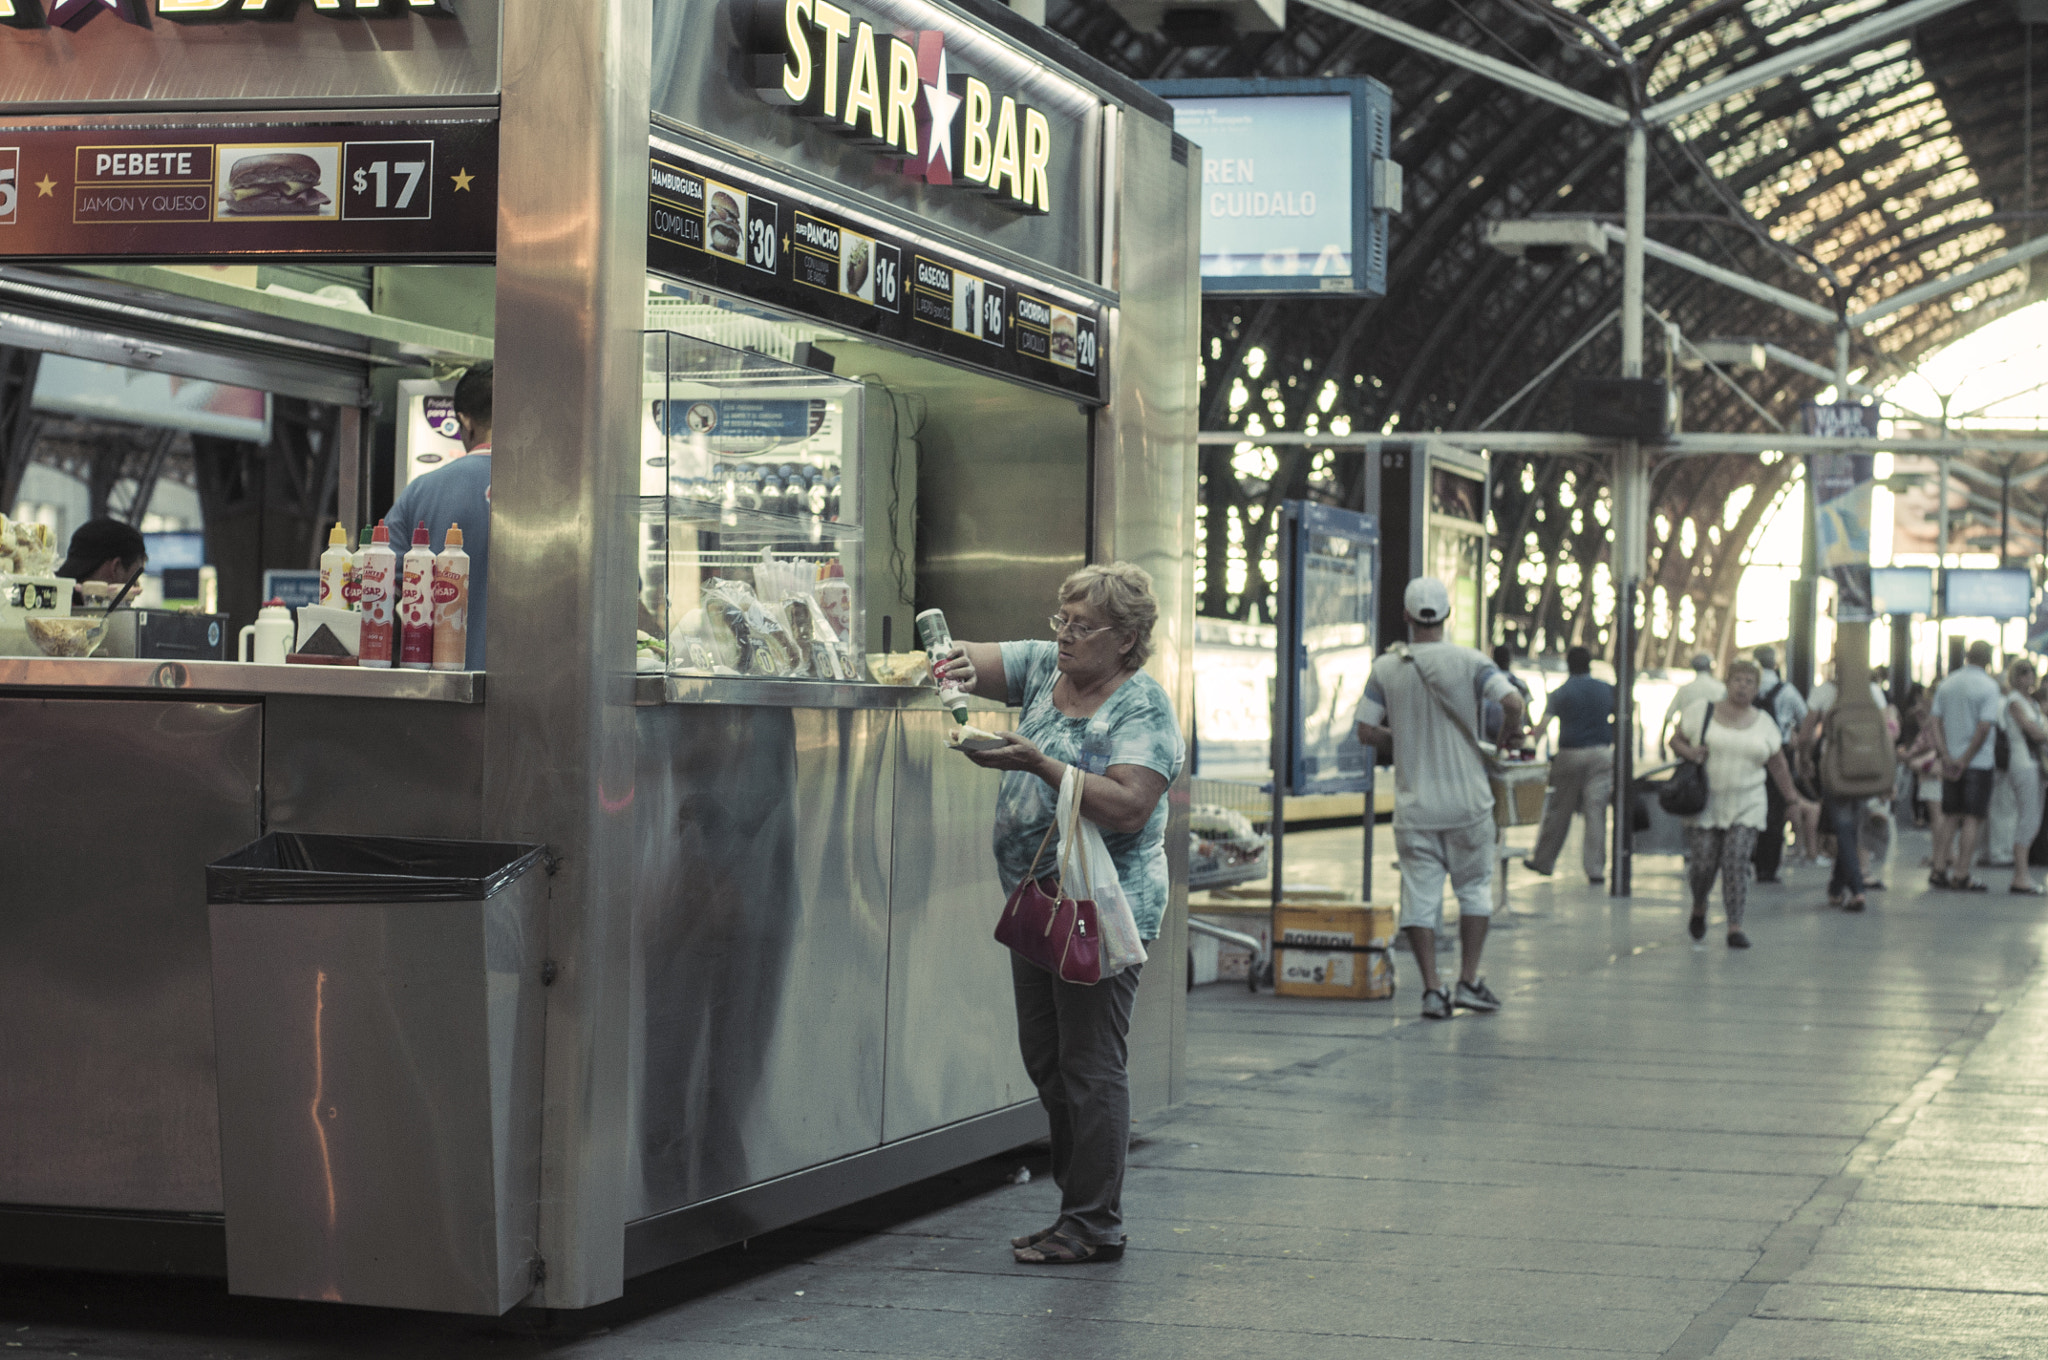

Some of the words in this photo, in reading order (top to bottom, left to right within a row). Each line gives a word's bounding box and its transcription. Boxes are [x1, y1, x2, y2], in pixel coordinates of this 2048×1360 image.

[783, 0, 918, 156] STAR
[964, 76, 1050, 213] BAR
[96, 152, 192, 176] PEBETE
[352, 160, 426, 209] $17
[651, 168, 703, 200] HAMBURGUESA
[79, 197, 134, 212] JAMON
[138, 196, 150, 211] Y
[152, 195, 207, 211] QUESO
[1210, 191, 1317, 217] CUIDALO
[654, 209, 700, 241] COMPLETA
[807, 222, 840, 251] PANCHO
[749, 218, 775, 269] $30
[877, 258, 897, 302] $16
[918, 263, 950, 291] GASEOSA
[984, 294, 1002, 335] $16
[1078, 330, 1096, 367] $20
